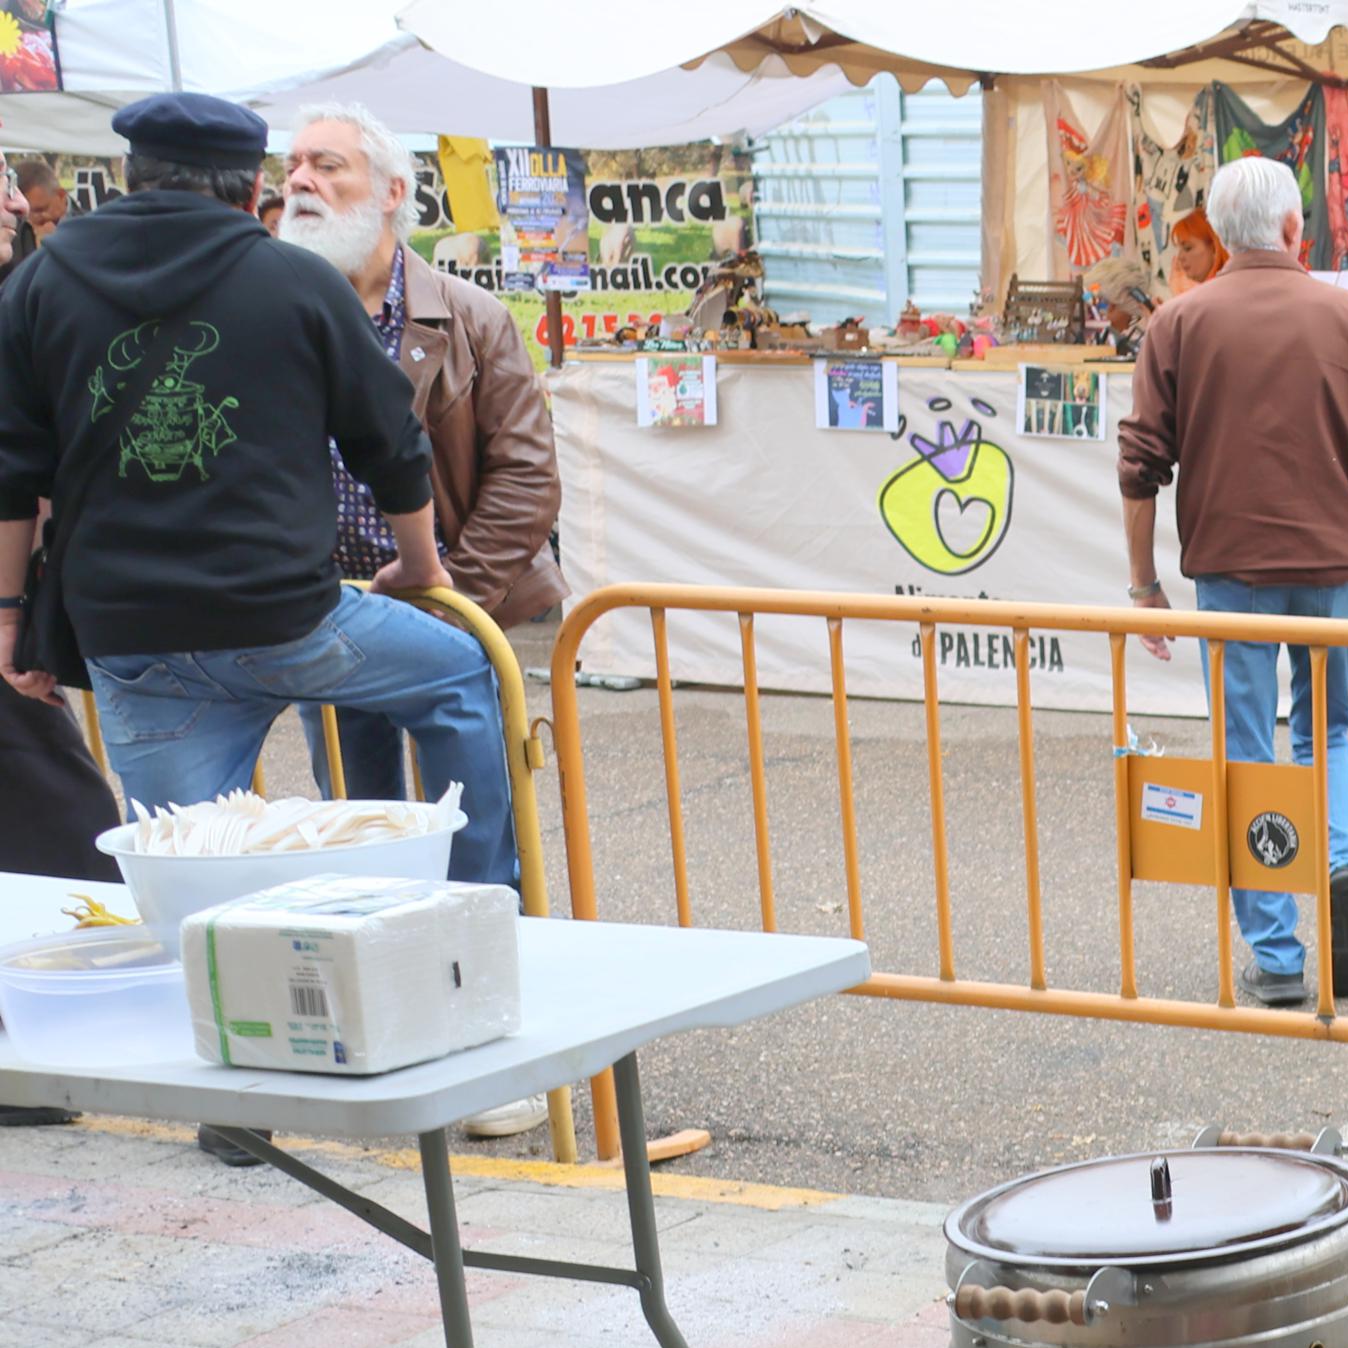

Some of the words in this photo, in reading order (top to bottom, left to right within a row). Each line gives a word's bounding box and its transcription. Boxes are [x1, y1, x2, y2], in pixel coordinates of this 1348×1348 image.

[506, 149, 530, 177] XII
[530, 153, 568, 177] OLLA
[508, 177, 569, 193] FERROVIARIA
